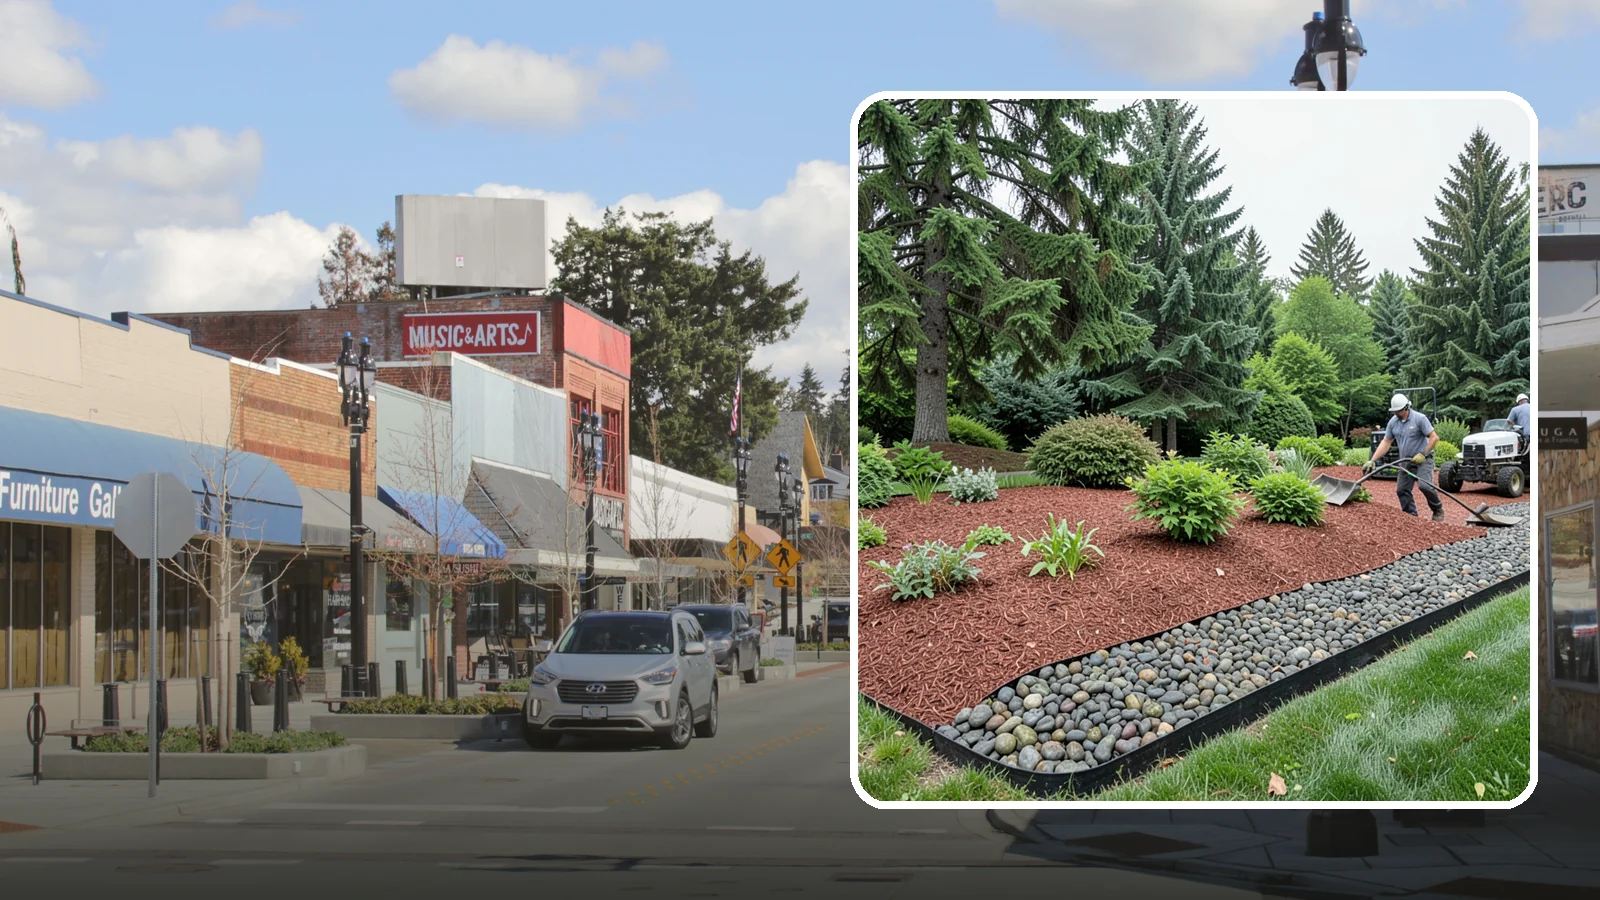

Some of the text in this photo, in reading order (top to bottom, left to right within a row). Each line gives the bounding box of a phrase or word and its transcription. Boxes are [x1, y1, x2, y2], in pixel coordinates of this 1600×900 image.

[1540, 427, 1578, 437] UGA
[0, 471, 79, 515] Furniture
[453, 563, 480, 575] SUSHI
